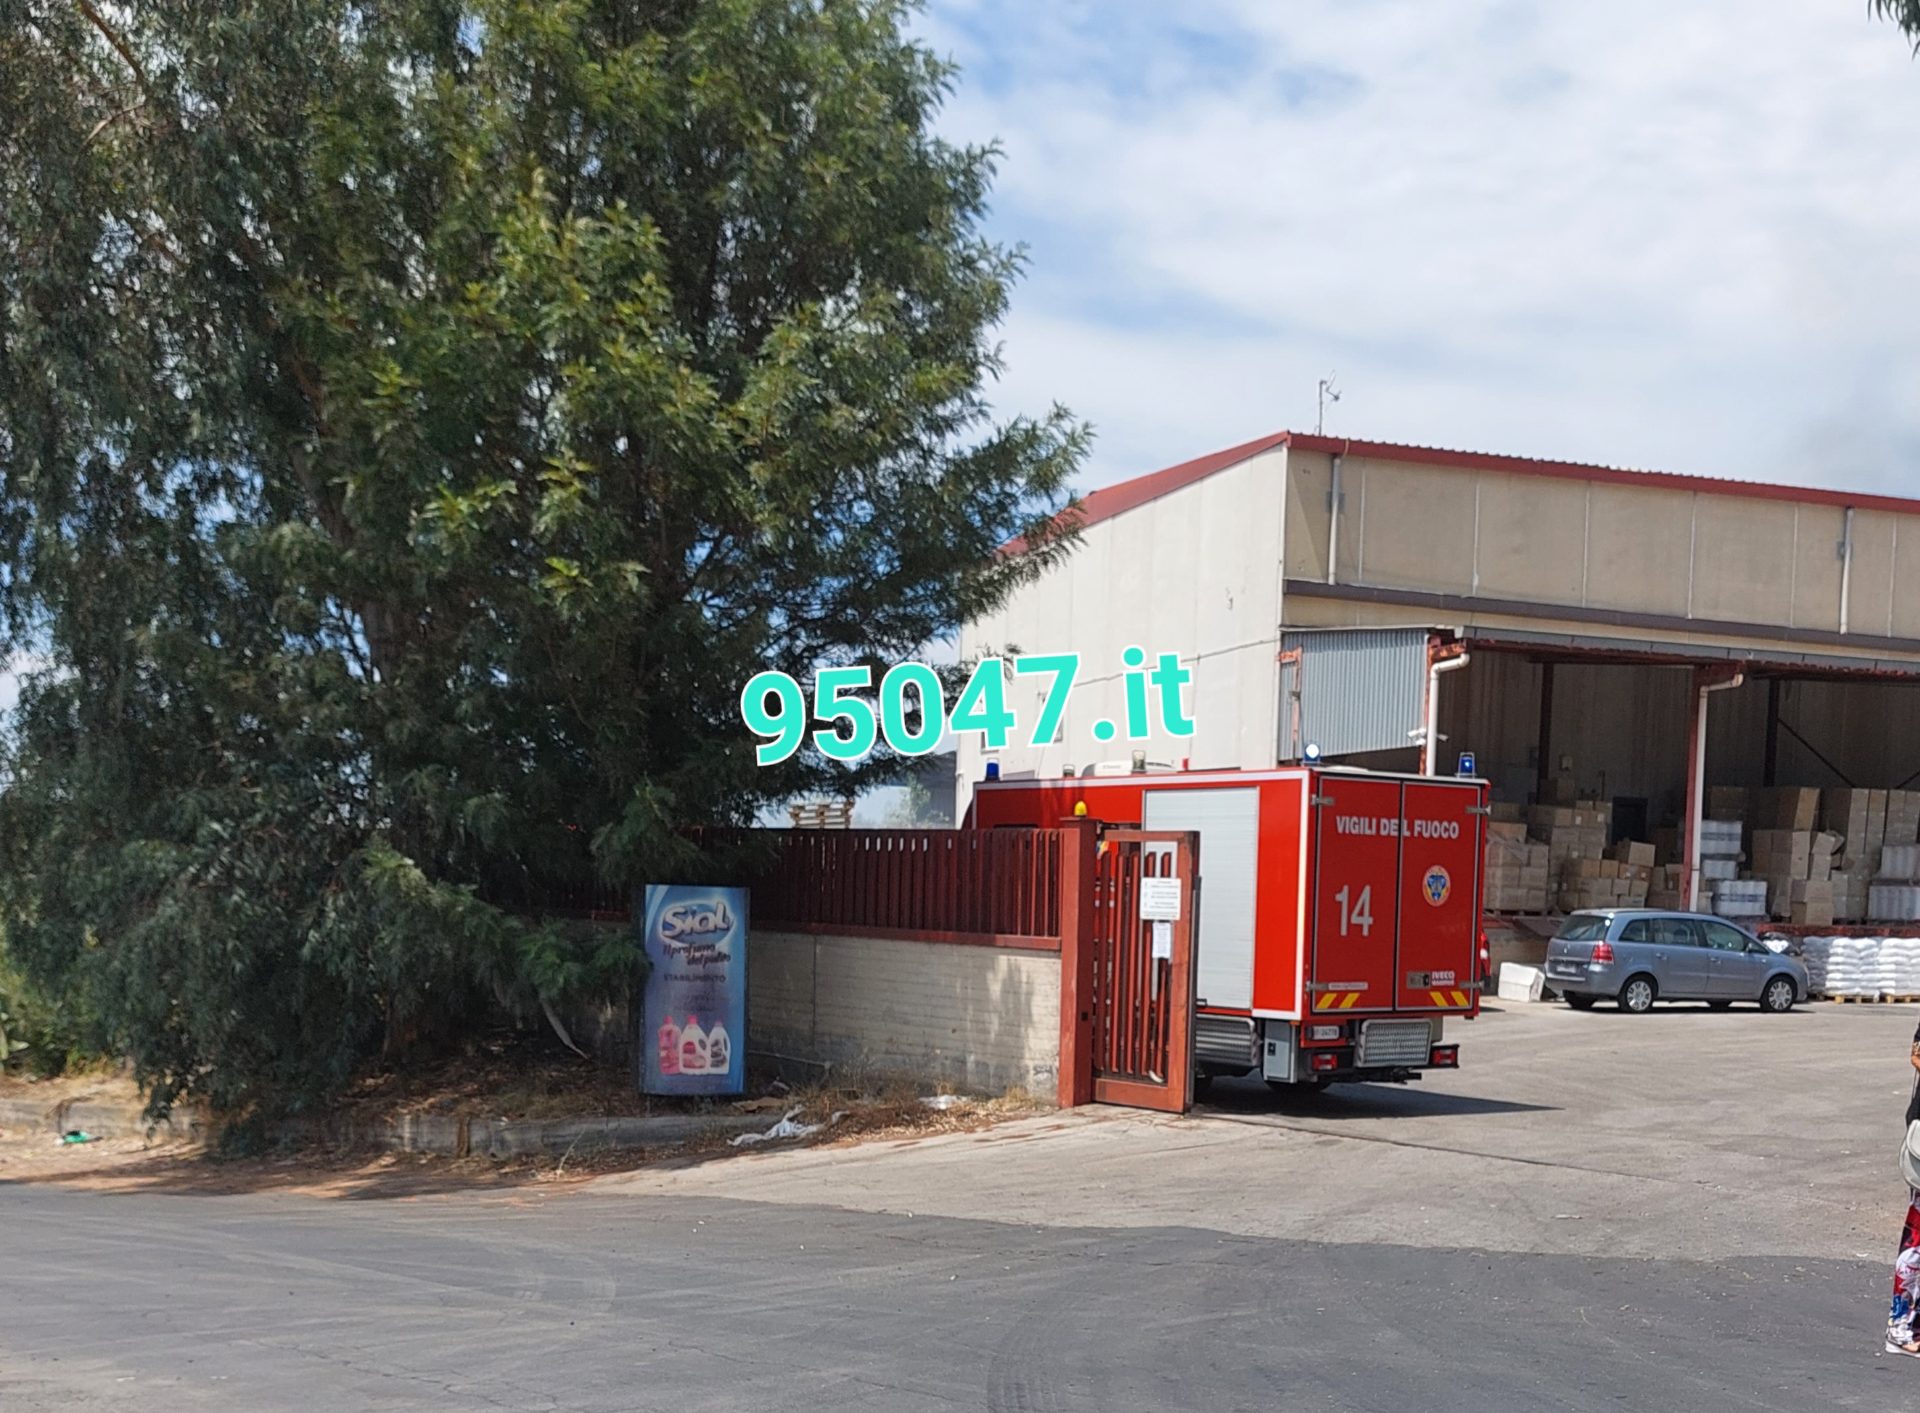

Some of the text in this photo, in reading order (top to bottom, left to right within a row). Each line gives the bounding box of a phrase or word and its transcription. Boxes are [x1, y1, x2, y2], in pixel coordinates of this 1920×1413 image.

[1336, 816, 1460, 839] VIGILI DEL FUOCO
[1335, 885, 1374, 937] 14
[1431, 970, 1455, 980] IVECO
